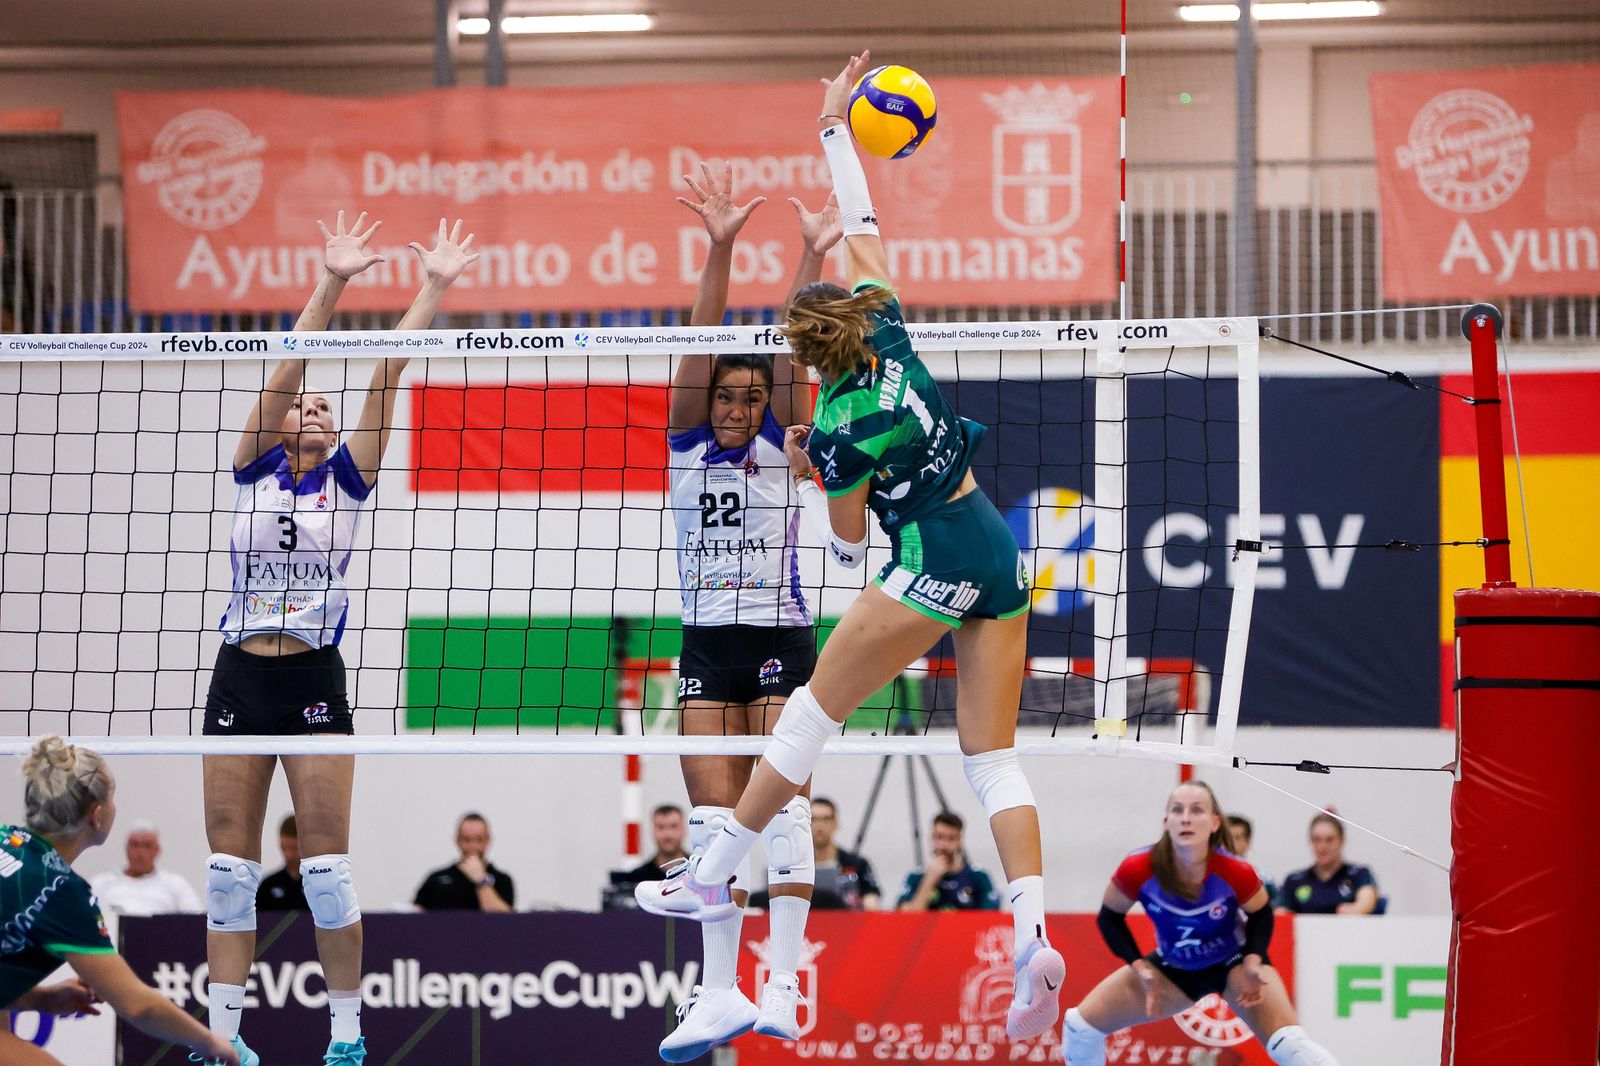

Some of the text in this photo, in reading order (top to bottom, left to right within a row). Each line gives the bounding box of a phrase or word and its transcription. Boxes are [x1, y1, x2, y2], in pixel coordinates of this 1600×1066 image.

[362, 147, 833, 203] Delegación de Deporte
[588, 228, 657, 285] de
[678, 226, 785, 285] Dos
[825, 234, 1084, 282] rmanas
[9, 342, 26, 350] CEV
[27, 341, 67, 351] Volleyball
[68, 341, 109, 351] Challenge
[110, 341, 127, 351] Cup
[128, 341, 148, 350] 2024
[161, 335, 268, 352] rfevb.com
[304, 338, 322, 347] CEV
[323, 338, 362, 348] Volleyball
[363, 338, 404, 348] Challenge
[406, 338, 423, 348] Cup
[424, 337, 444, 346] 2024
[456, 332, 564, 349] rfevb.com
[596, 335, 612, 344] CEV
[614, 335, 654, 345] Volleyball
[655, 334, 696, 344] Challenge
[698, 334, 715, 344] Cup
[716, 334, 737, 342] 2024
[917, 330, 957, 340] Volleyball
[958, 330, 1000, 339] Challenge
[1002, 330, 1020, 339] Cup
[1021, 329, 1042, 338] 2024
[1057, 323, 1168, 341] rfev.com
[699, 492, 741, 528] 22
[278, 516, 298, 551] 3
[685, 531, 768, 557] FATUM
[1143, 511, 1365, 590] CEV
[245, 554, 333, 581] FATUM
[914, 574, 981, 611] berlin
[855, 1022, 924, 1043] DOS
[873, 1041, 995, 1061] CIUDAD
[1008, 1044, 1065, 1062] PAR
